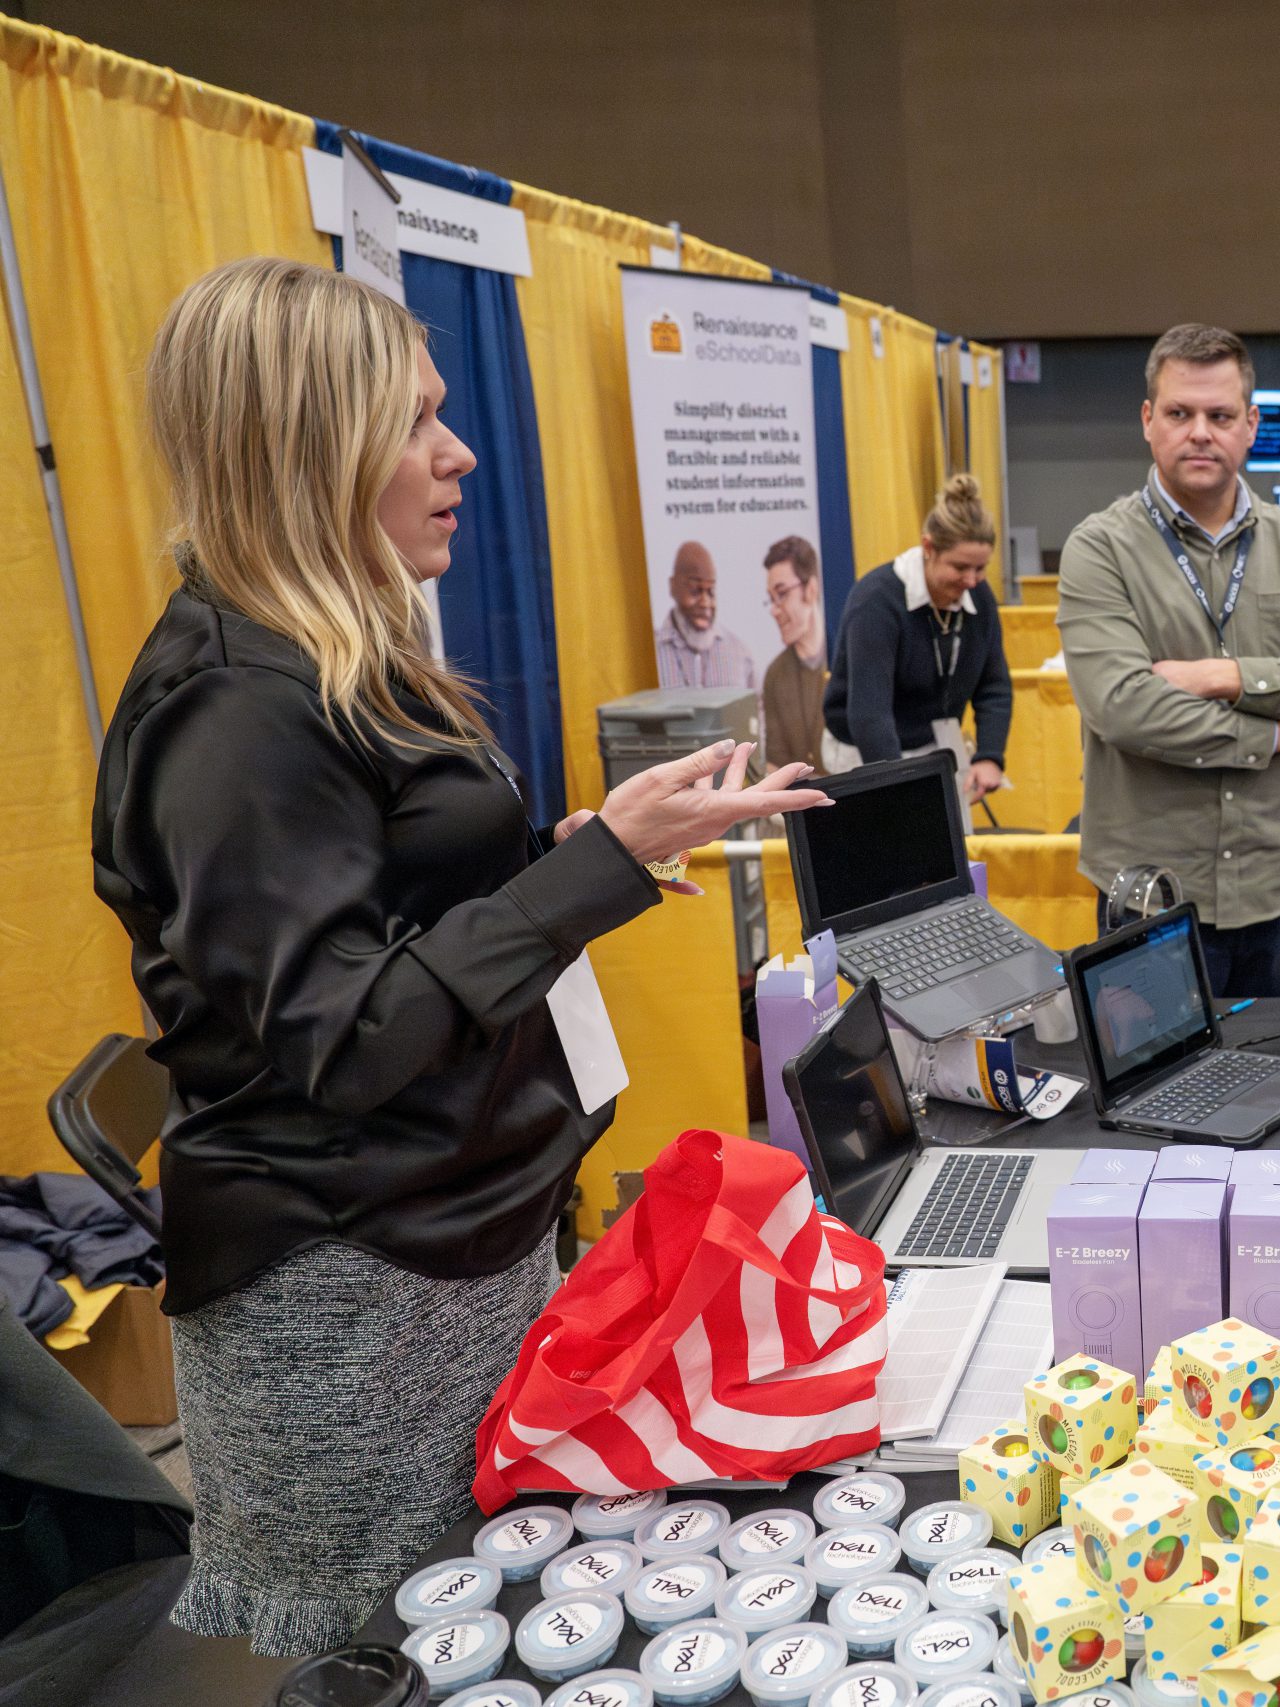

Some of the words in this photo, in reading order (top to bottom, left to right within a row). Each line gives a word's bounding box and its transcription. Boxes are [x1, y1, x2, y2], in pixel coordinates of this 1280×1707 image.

[397, 209, 479, 244] naissance
[693, 311, 798, 341] Renaissance
[696, 341, 801, 366] eSchoolData
[674, 401, 734, 420] Simplify
[737, 402, 788, 419] district
[664, 428, 756, 444] management
[759, 427, 790, 442] with
[793, 431, 800, 442] a
[666, 450, 718, 466] flexible
[721, 450, 748, 465] and
[750, 450, 801, 465] reliable
[666, 475, 720, 490] student
[722, 474, 805, 490] information
[665, 500, 715, 519] system
[717, 498, 736, 513] for
[738, 498, 809, 513] educators.
[1055, 1247, 1080, 1258] E-Z
[1082, 1247, 1131, 1261] Breezy
[1237, 1245, 1262, 1257] E-Z
[1181, 1364, 1215, 1390] MOLECOOL
[1062, 1419, 1077, 1464] MOLECOOL
[836, 1491, 876, 1511] DELL
[513, 1519, 542, 1546] DELL
[663, 1512, 694, 1541] DELL
[754, 1520, 790, 1546] DELL
[928, 1513, 949, 1543] DELL
[829, 1541, 877, 1554] DELL
[577, 1555, 614, 1579] DELL
[949, 1567, 1001, 1582] DELL
[431, 1573, 477, 1605] DELL
[652, 1578, 695, 1598] DELL
[748, 1578, 796, 1607] DELL
[856, 1591, 902, 1610] DELL
[547, 1612, 584, 1645] DELL
[435, 1628, 455, 1664] DELL
[674, 1635, 699, 1673] DELL
[769, 1639, 804, 1675] DELL
[1056, 1660, 1109, 1686] MOLECOOL
